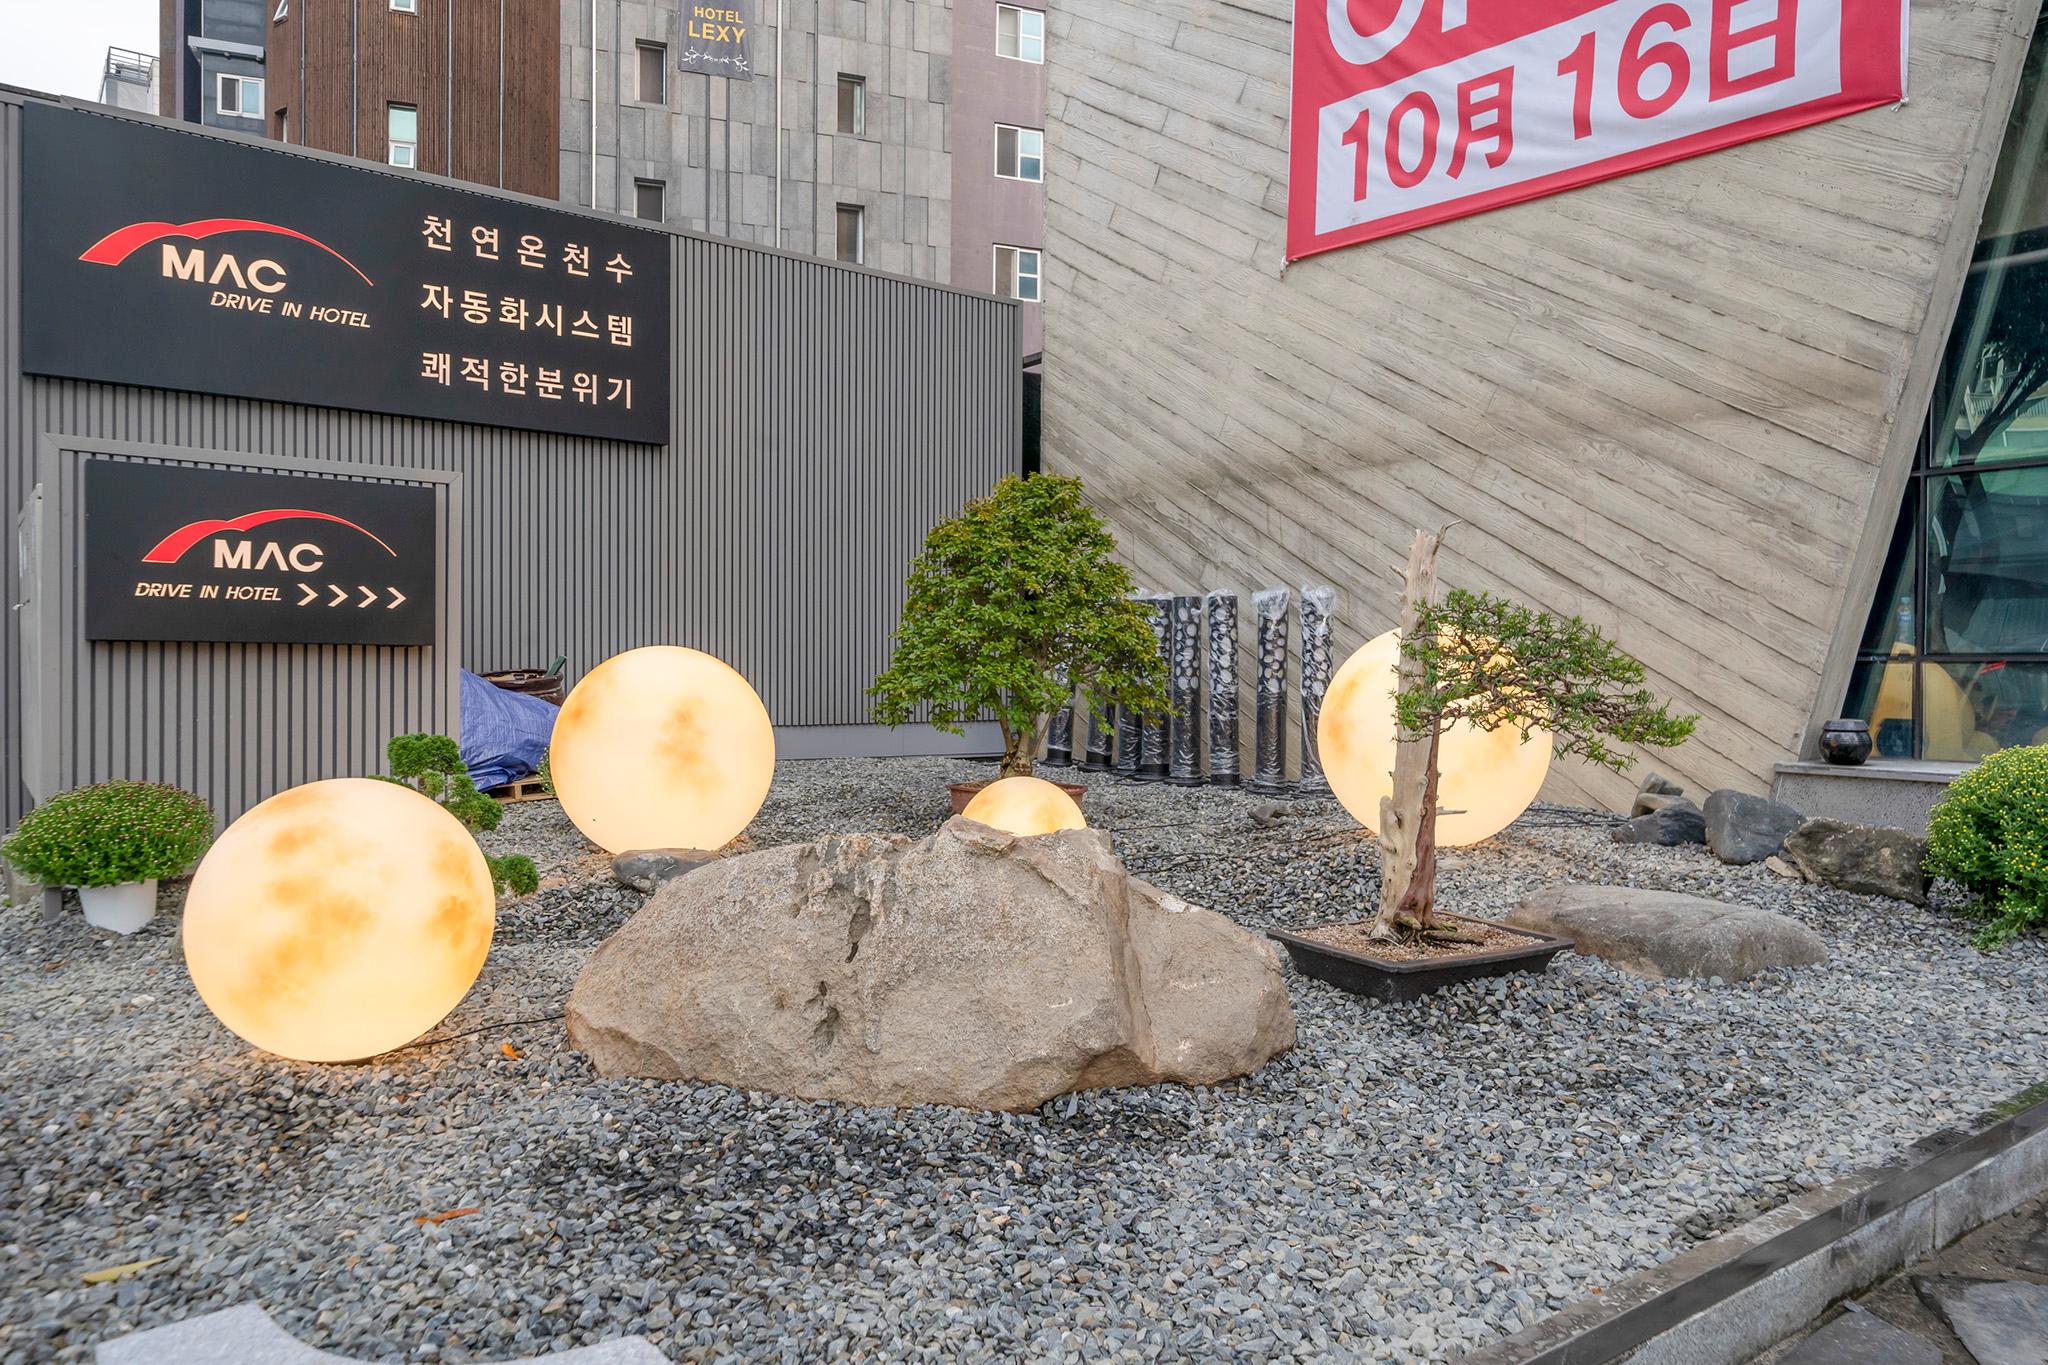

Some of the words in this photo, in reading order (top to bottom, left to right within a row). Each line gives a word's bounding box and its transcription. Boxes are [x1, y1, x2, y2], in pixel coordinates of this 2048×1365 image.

[688, 20, 746, 43] LEXY
[694, 6, 744, 24] HOTEL
[1341, 65, 1515, 203] 10月
[1557, 0, 1799, 140] 16日
[162, 243, 287, 294] MAC
[210, 290, 274, 315] DRIVE
[281, 301, 303, 318] IN
[309, 305, 371, 329] HOTEL
[420, 283, 634, 347] 자동화시스템
[213, 538, 324, 573] MAC
[134, 582, 193, 598] DRIVE
[199, 584, 220, 599] IN
[225, 585, 282, 601] HOTEL
